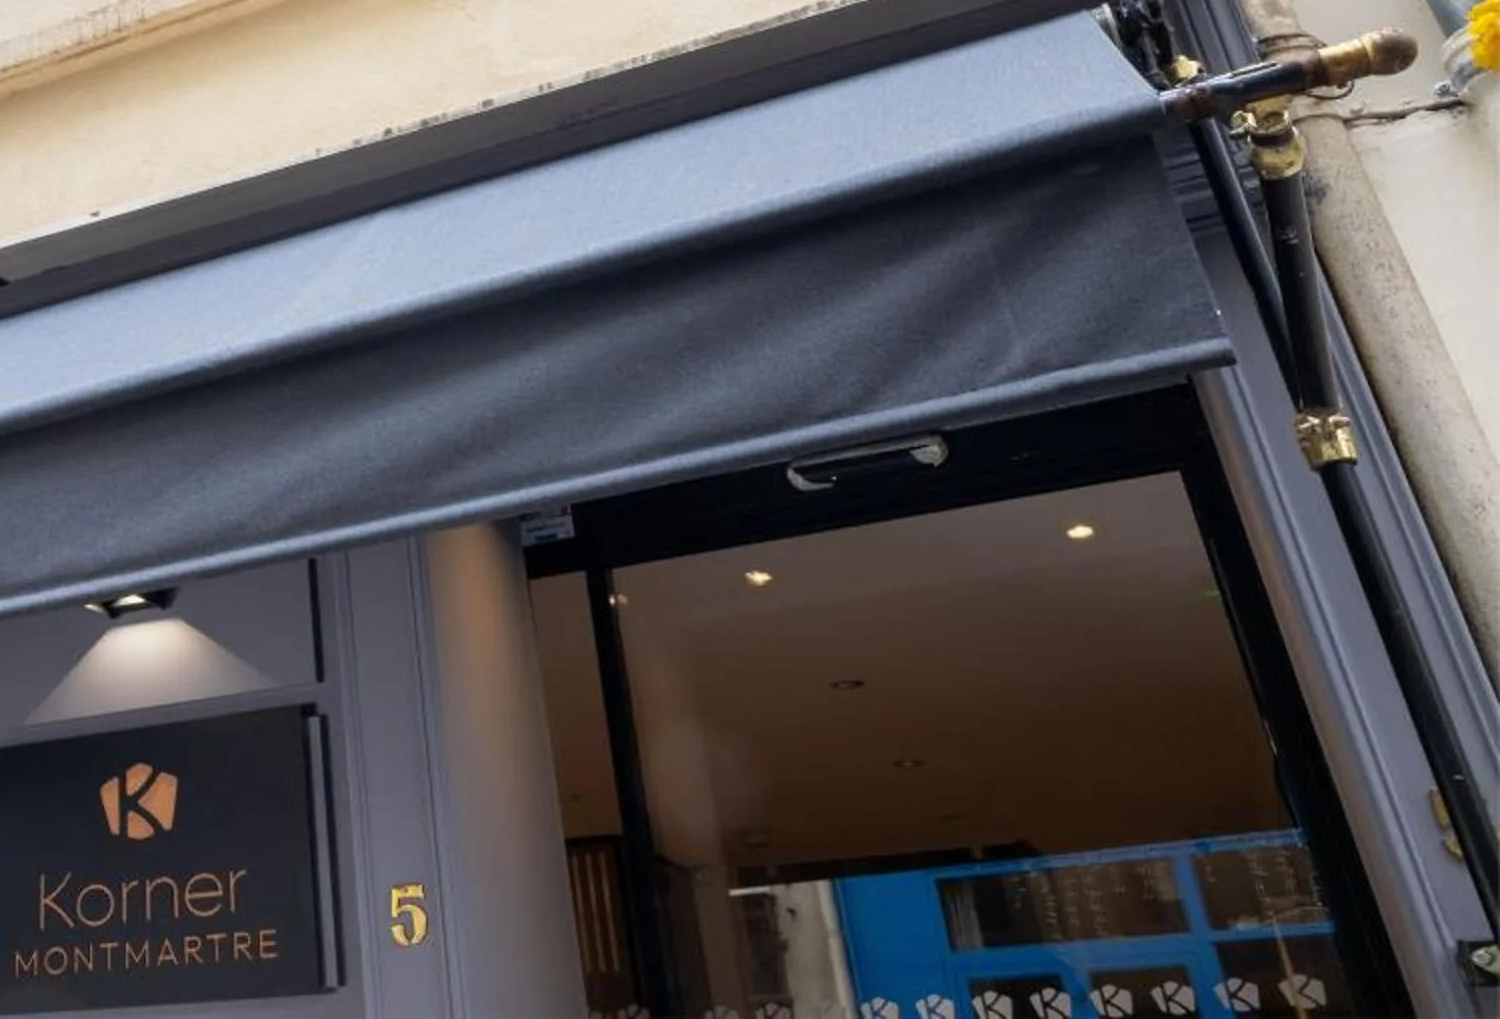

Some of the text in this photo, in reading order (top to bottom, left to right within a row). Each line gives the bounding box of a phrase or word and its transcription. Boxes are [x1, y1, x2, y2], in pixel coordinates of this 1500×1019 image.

[38, 868, 248, 932] Korner
[388, 883, 429, 949] 5
[14, 928, 279, 978] MONTMARTRE
